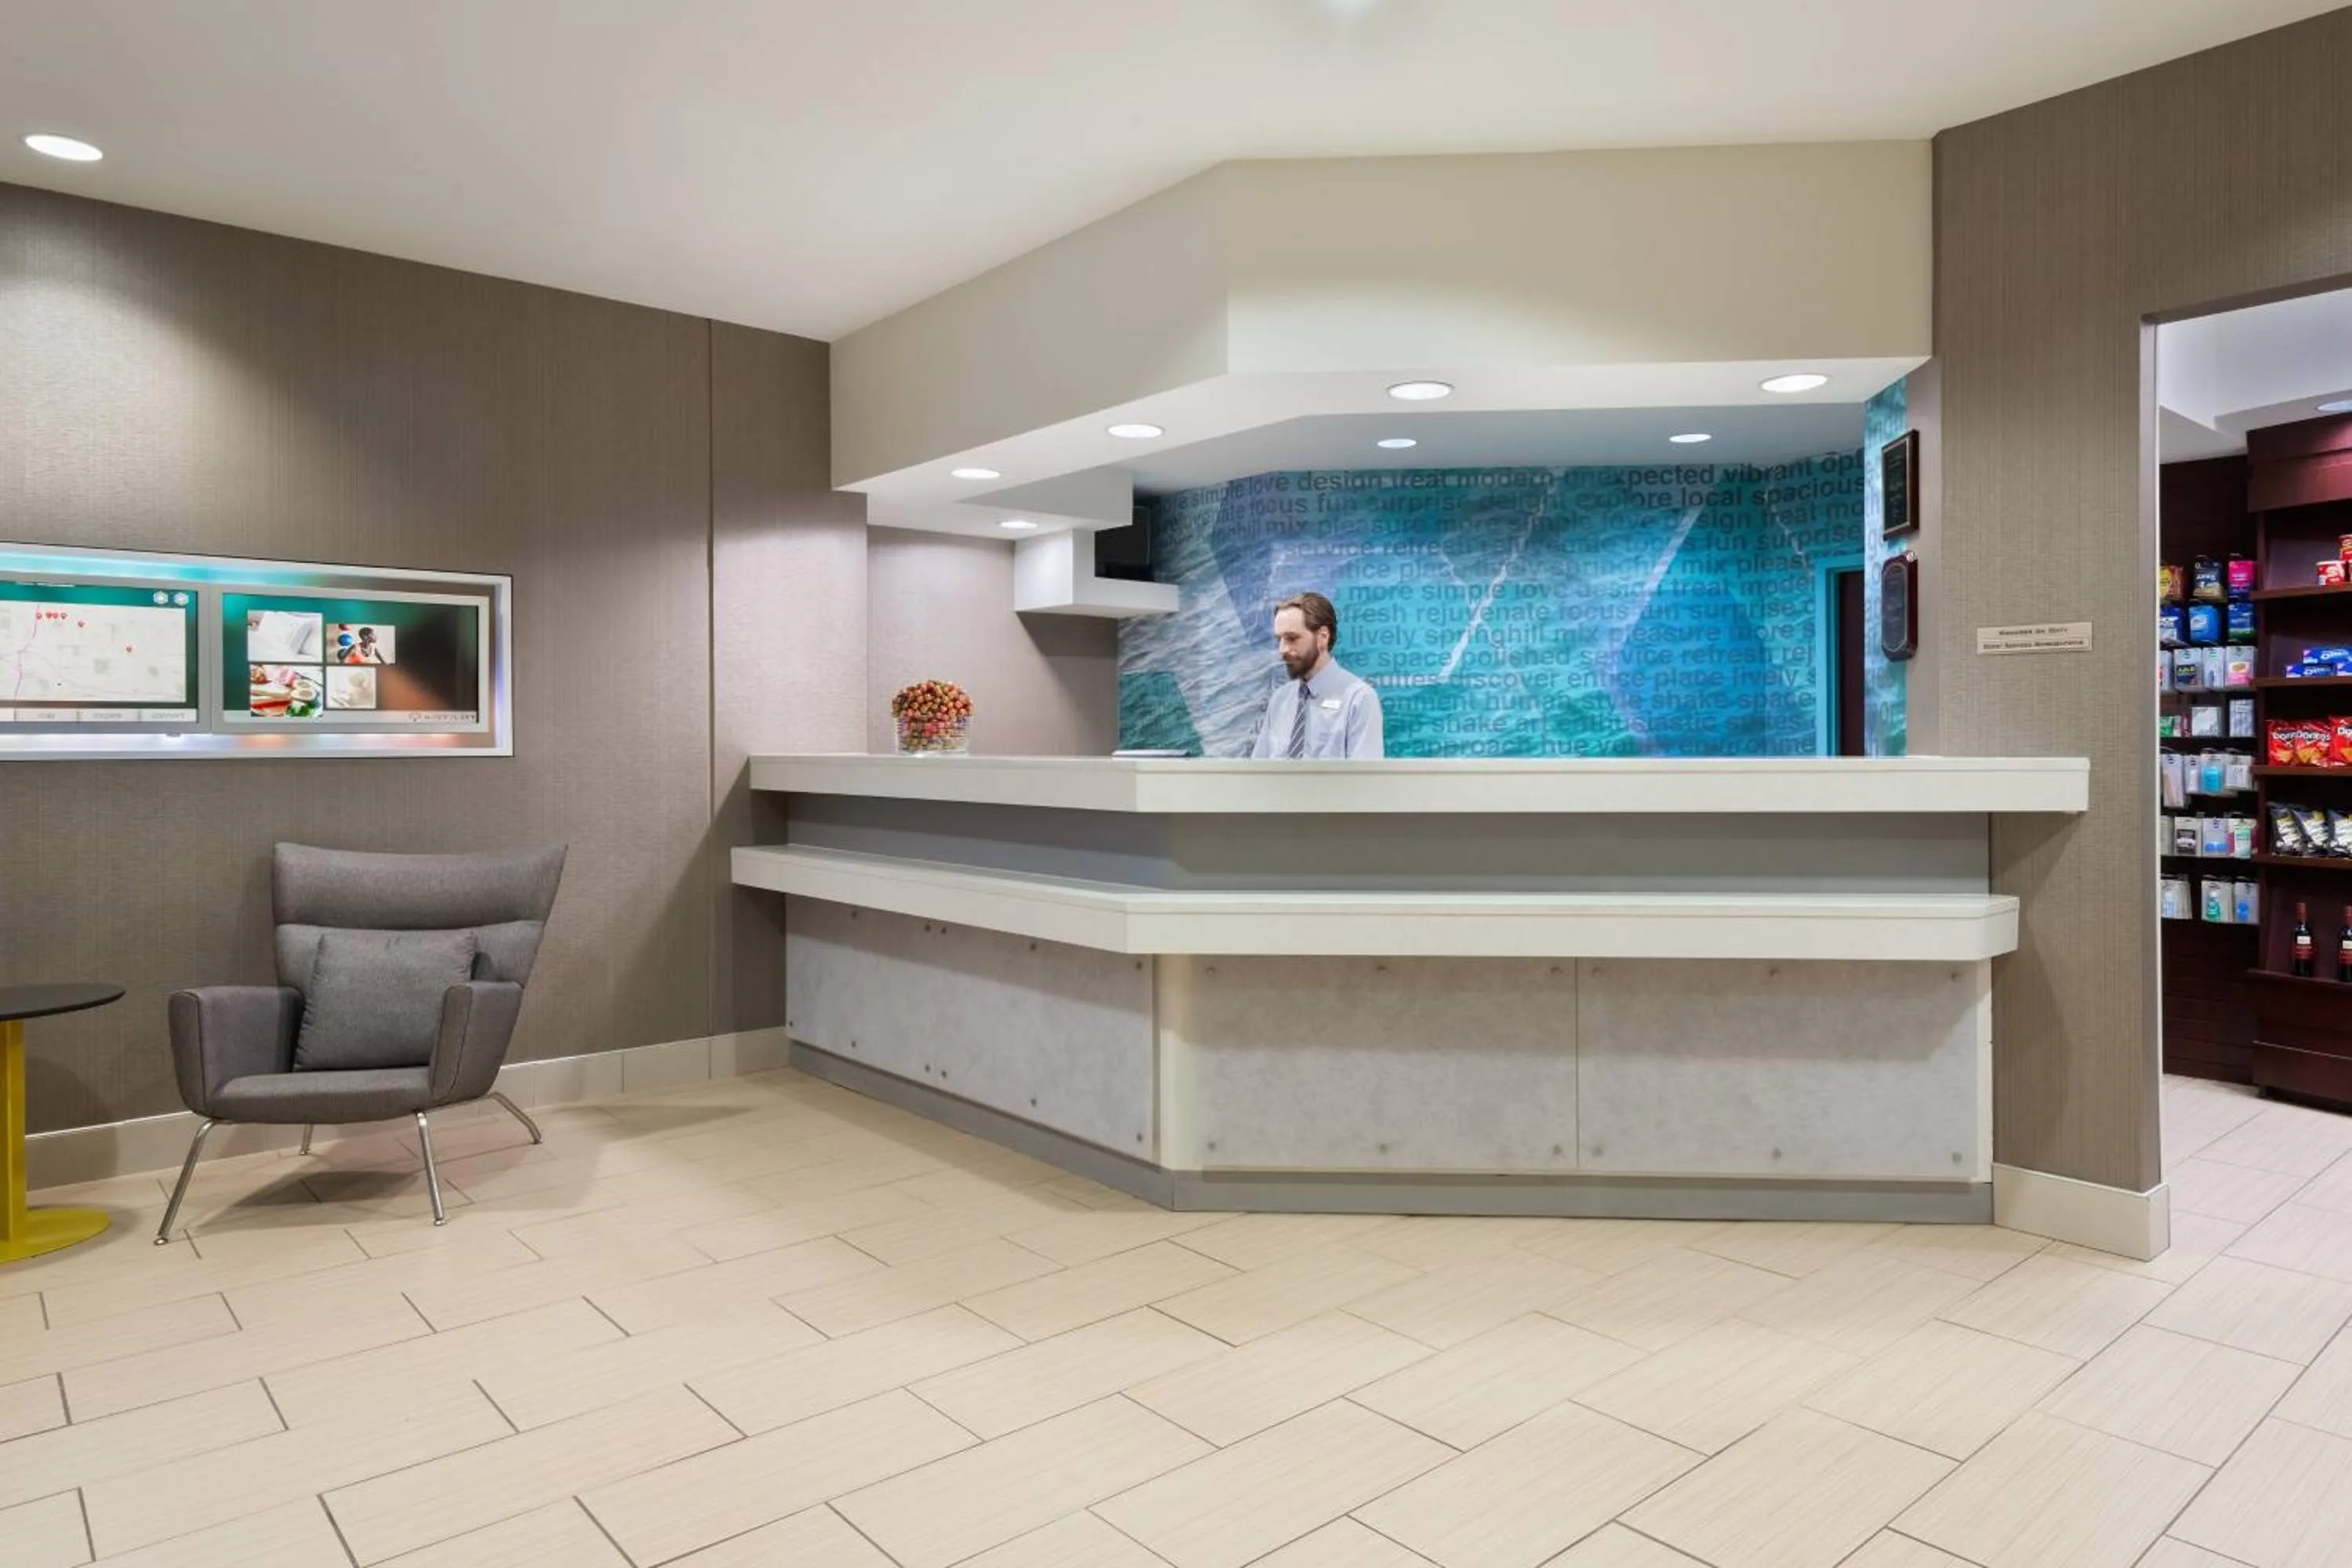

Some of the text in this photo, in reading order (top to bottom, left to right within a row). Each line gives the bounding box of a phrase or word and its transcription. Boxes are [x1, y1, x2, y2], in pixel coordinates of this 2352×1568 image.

[1190, 480, 1243, 508] simple
[1249, 474, 1290, 495] love
[1298, 470, 1382, 495] design
[1458, 467, 1554, 489] modern
[1722, 459, 1811, 484] vibrant
[1250, 495, 1308, 519] focus
[1318, 492, 1357, 514] fun
[1366, 494, 1466, 517] surprise
[1576, 486, 1673, 513] explore
[1681, 486, 1742, 507] local
[1751, 476, 1864, 510] spacious
[1266, 517, 1308, 535] mix
[1663, 506, 1752, 534] dsign
[1762, 499, 1817, 528] treat
[1707, 532, 1748, 550] fun
[1756, 523, 1862, 554] surprise
[1682, 555, 1728, 574] mix
[1737, 548, 1849, 579] pleas
[1348, 585, 1413, 601] more
[1421, 583, 1506, 607] simple
[1515, 583, 1567, 600] love
[1670, 579, 1731, 597] treat
[1338, 601, 1406, 623] fresh
[1417, 602, 1549, 627] rejuvenate
[1559, 603, 1629, 621] focus
[1690, 598, 1795, 626] surprise
[1350, 625, 1417, 649] lively
[1425, 623, 1546, 649] springhill
[1553, 624, 1599, 643] mix
[1728, 622, 1795, 643] more
[1377, 652, 1451, 672] space
[1462, 646, 1570, 672] polished
[1581, 648, 1674, 666] service
[1681, 644, 1773, 665] refresh
[1450, 668, 1561, 689] discover
[1569, 668, 1646, 688] entice
[1656, 666, 1724, 691] place
[1486, 691, 1569, 712] human
[1652, 690, 1726, 710] shake
[1737, 690, 1816, 713] space
[1436, 713, 1507, 733] shake
